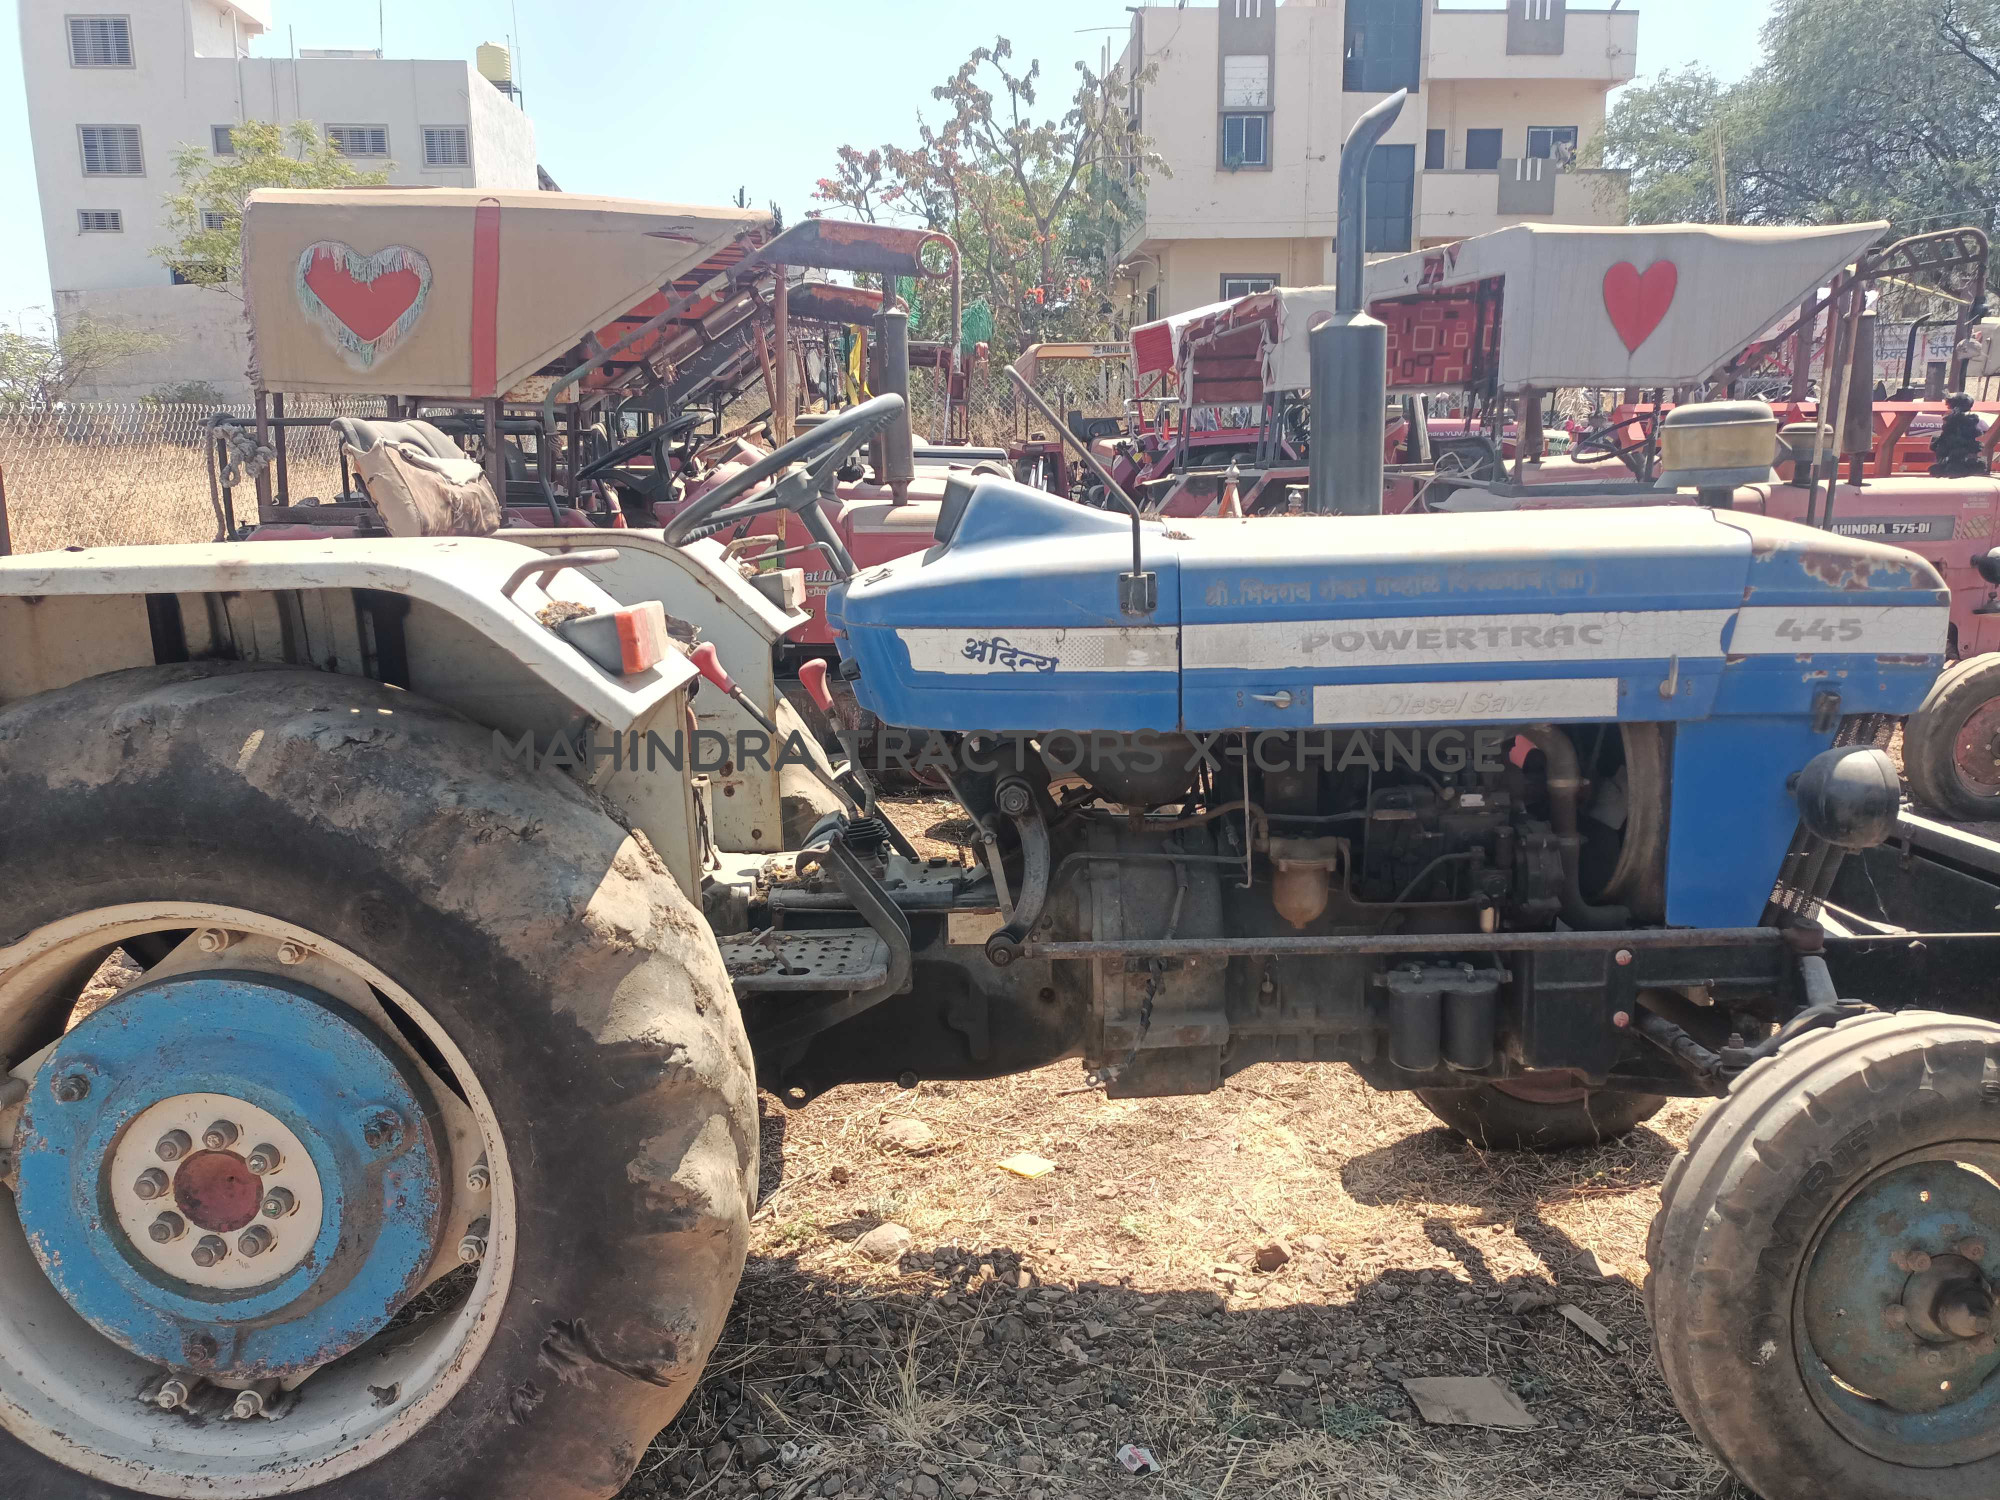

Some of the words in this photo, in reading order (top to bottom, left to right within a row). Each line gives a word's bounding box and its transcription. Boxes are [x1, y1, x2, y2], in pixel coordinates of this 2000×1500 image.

[1892, 523, 1930, 534] 575-DI
[1301, 625, 1604, 653] POWERTRAC
[1775, 618, 1863, 642] 445
[1378, 691, 1469, 715] Diesel
[1470, 690, 1550, 713] Saver
